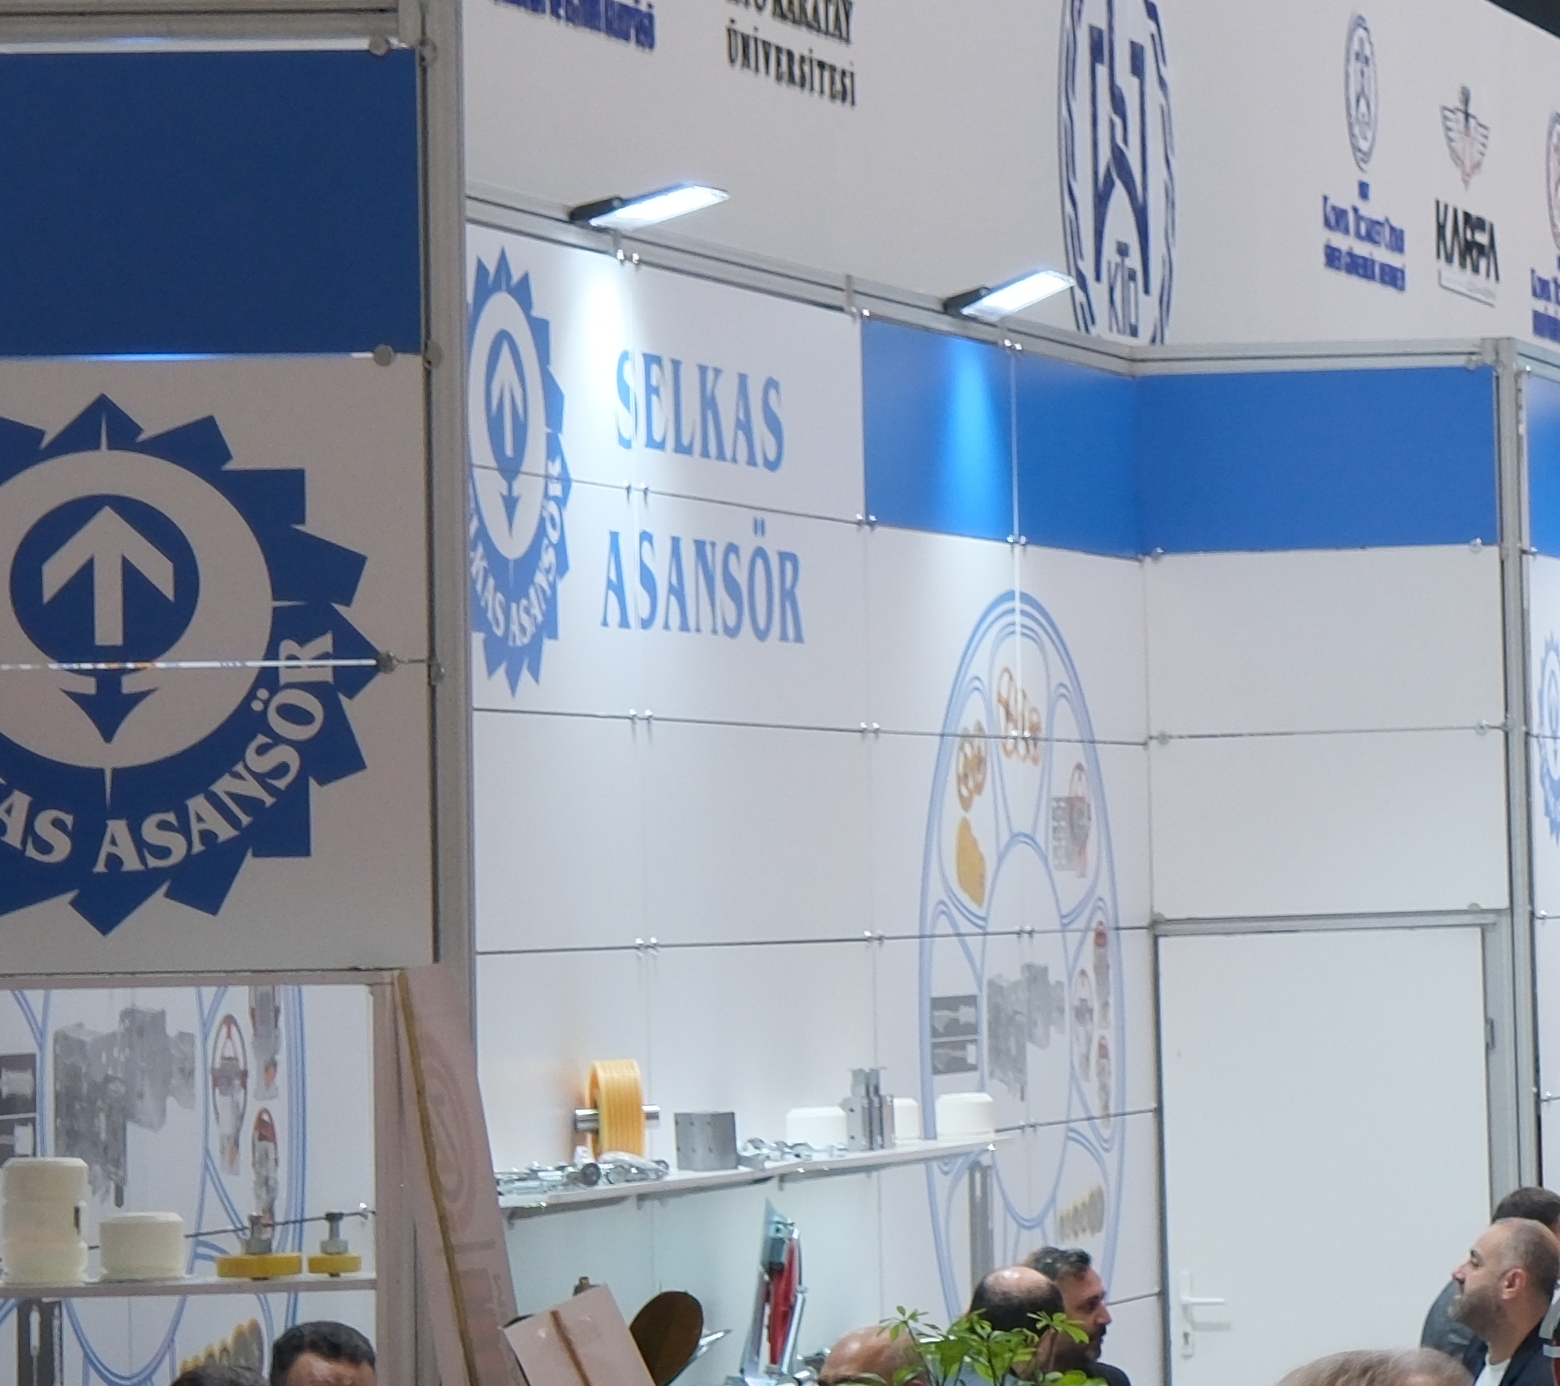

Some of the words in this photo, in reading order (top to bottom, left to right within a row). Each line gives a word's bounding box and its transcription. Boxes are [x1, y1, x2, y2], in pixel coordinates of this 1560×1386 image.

[616, 347, 784, 474] SELKAS
[600, 517, 805, 645] ASANSÖR
[93, 630, 334, 874] ASANSÖR
